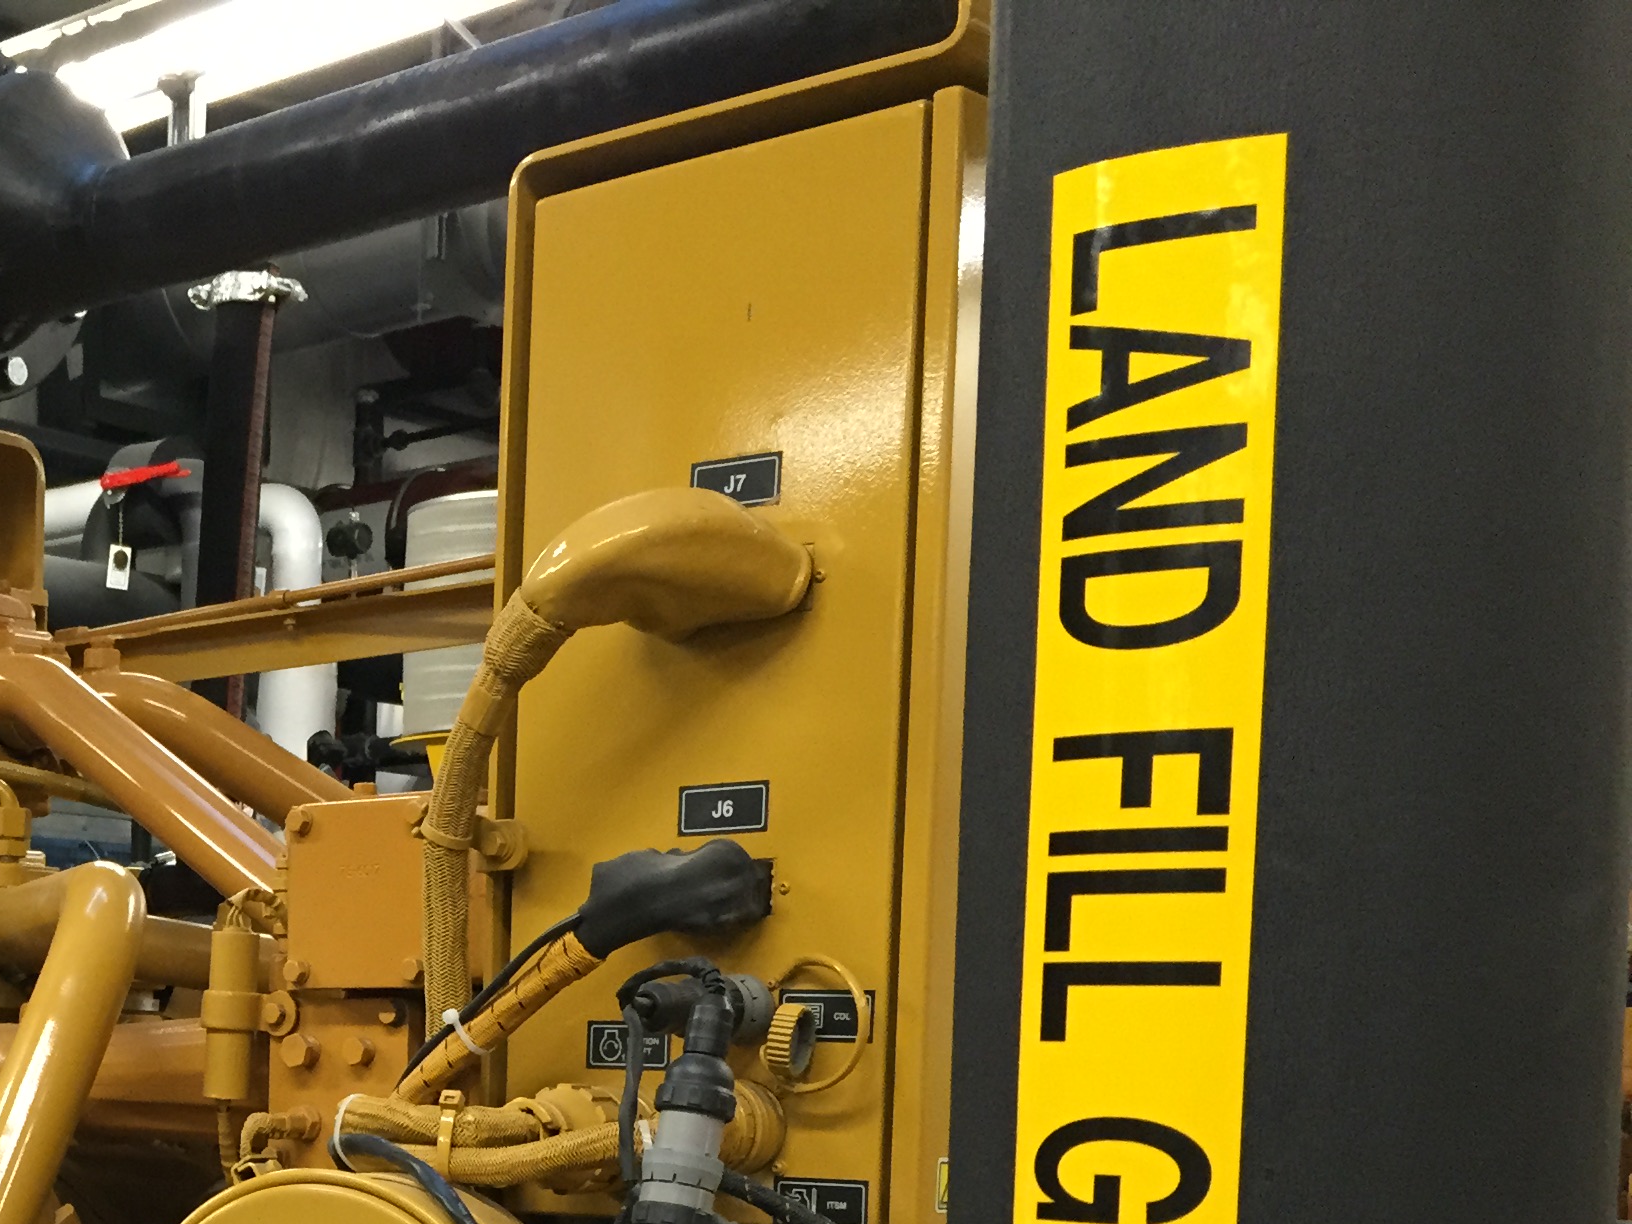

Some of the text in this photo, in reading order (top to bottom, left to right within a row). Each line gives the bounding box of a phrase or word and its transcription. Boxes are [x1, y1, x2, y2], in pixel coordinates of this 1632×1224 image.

[723, 473, 747, 493] J7
[1060, 205, 1256, 649] LAND
[711, 799, 734, 818] J6
[1041, 728, 1233, 1041] FILL
